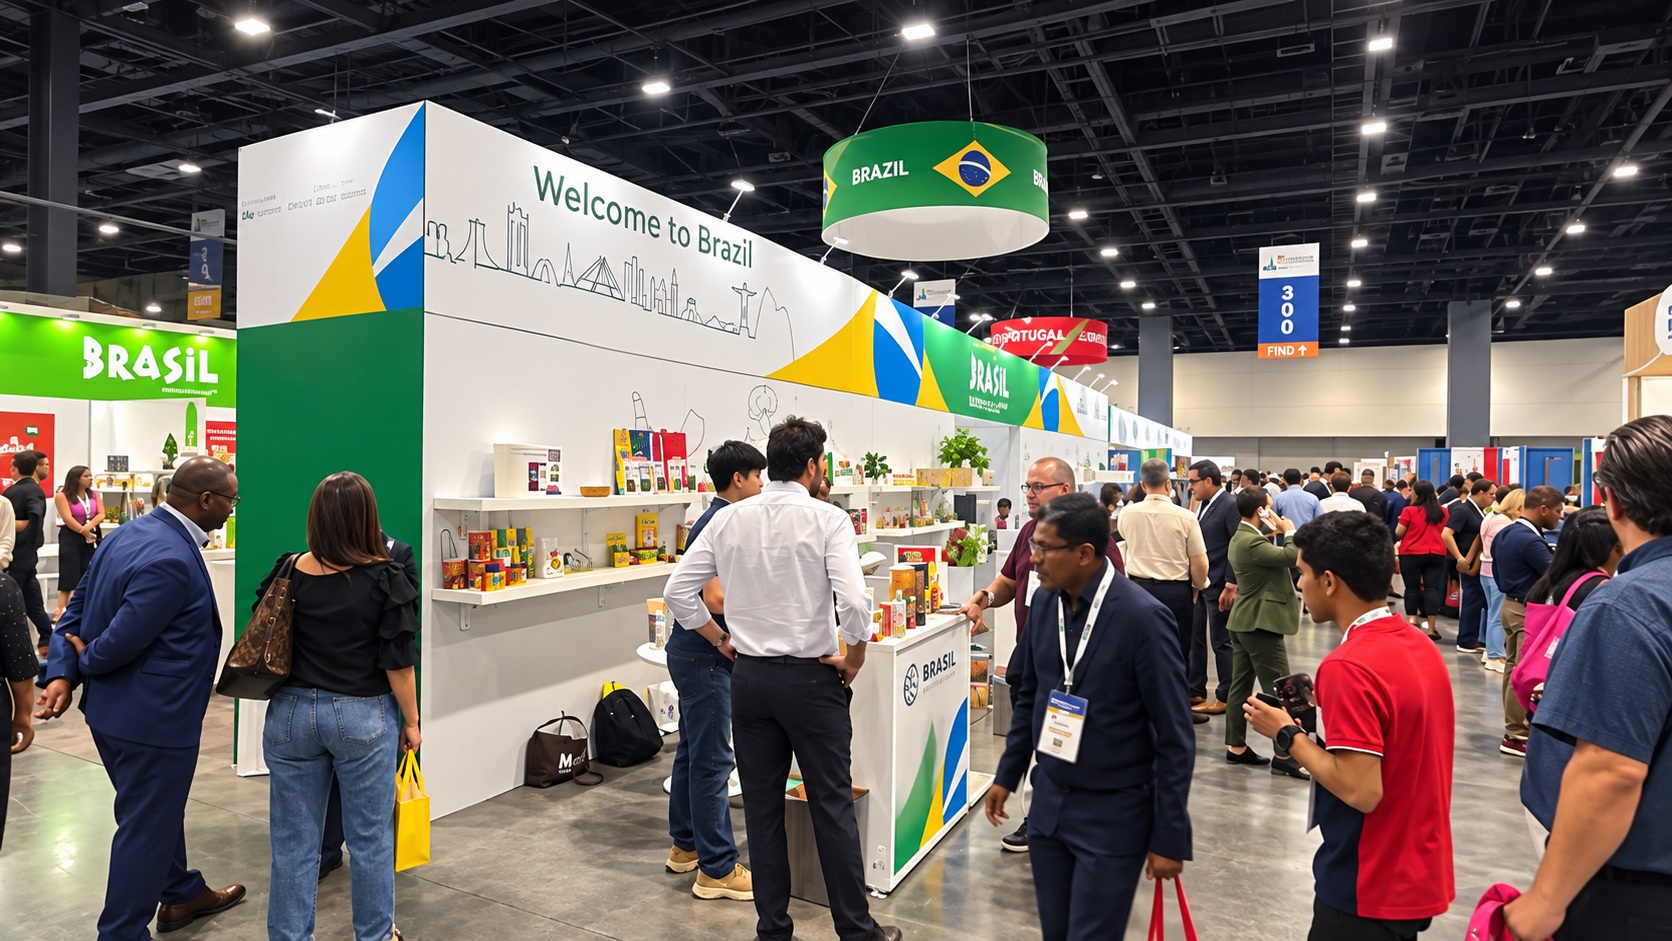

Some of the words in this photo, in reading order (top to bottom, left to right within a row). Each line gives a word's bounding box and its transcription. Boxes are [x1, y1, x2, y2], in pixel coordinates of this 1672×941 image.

[852, 159, 909, 186] BRAZIL
[533, 165, 661, 239] Welcome
[668, 215, 691, 248] to
[698, 224, 753, 269] Brazil
[1267, 345, 1295, 357] FIND
[922, 650, 957, 682] BRASIL
